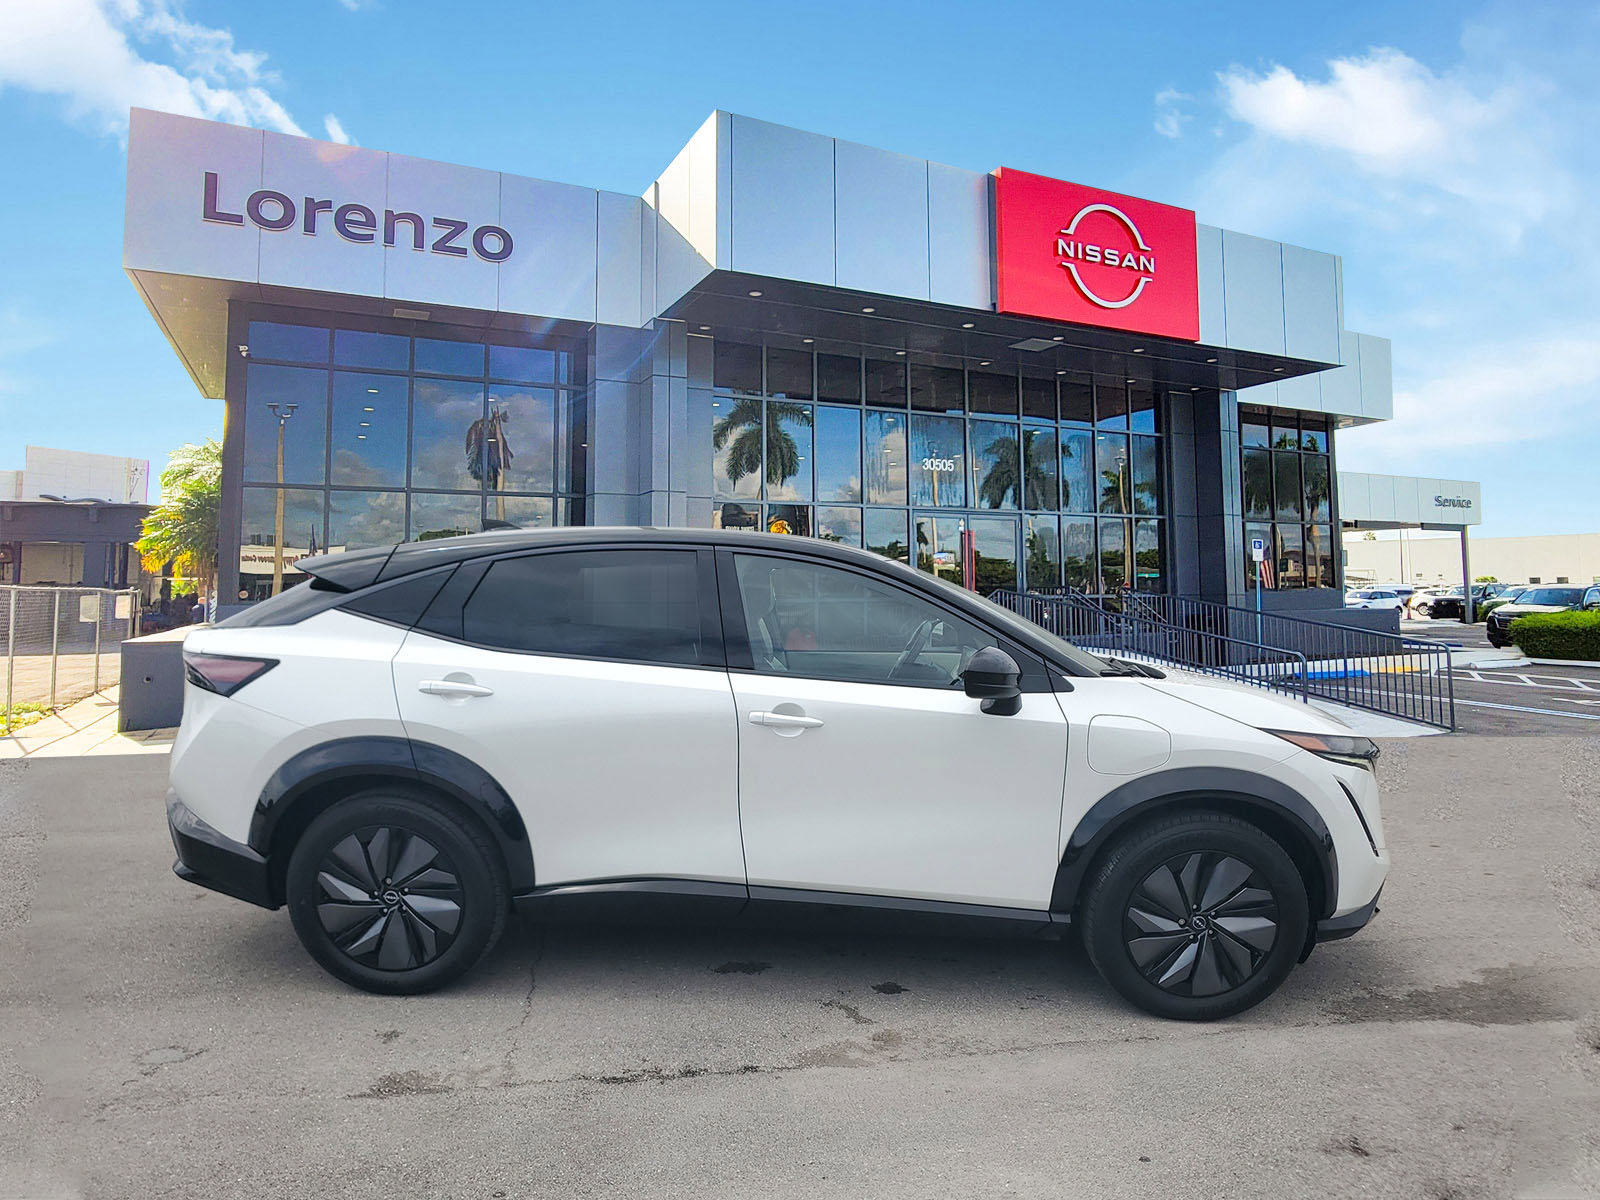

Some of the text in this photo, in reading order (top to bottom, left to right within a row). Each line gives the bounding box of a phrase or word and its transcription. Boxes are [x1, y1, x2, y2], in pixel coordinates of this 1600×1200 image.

[202, 171, 514, 262] Lorenzo
[1057, 238, 1155, 273] NISSAN
[922, 457, 955, 472] 30505
[1434, 495, 1472, 509] Service
